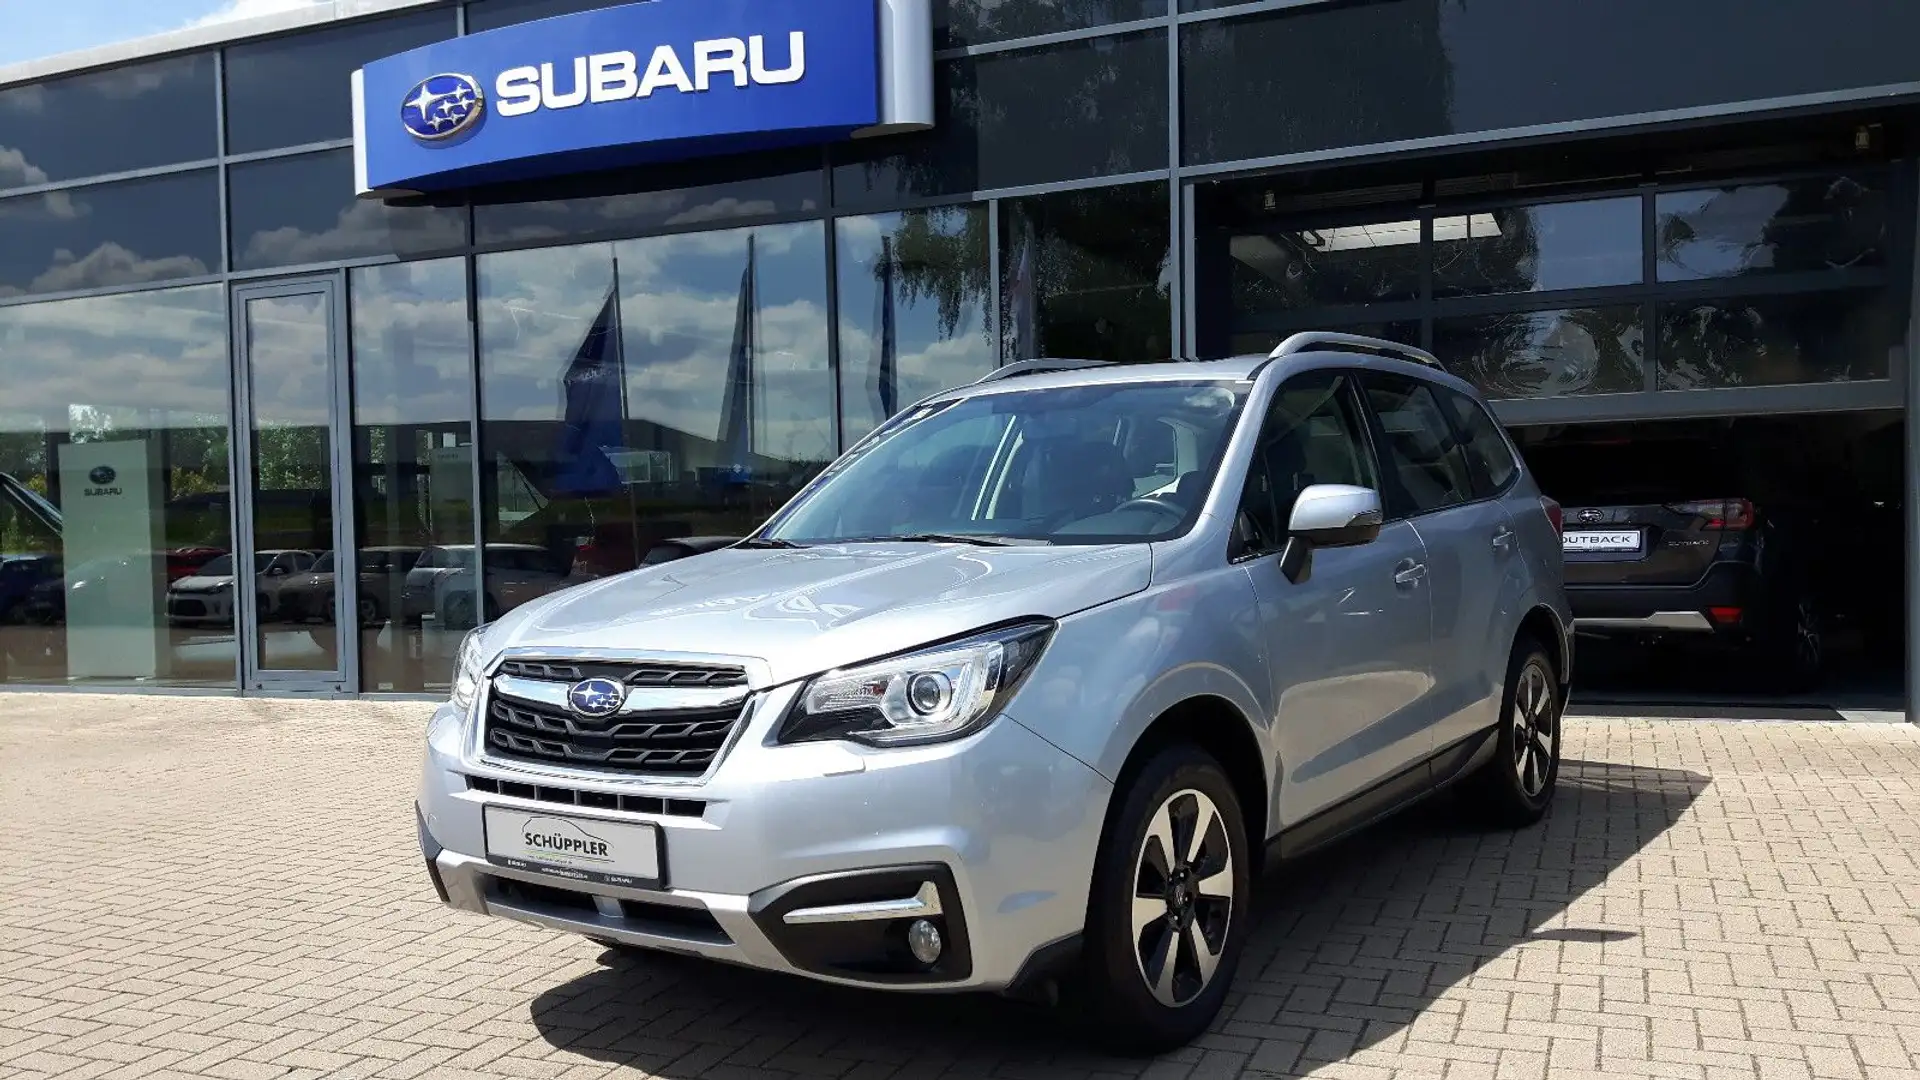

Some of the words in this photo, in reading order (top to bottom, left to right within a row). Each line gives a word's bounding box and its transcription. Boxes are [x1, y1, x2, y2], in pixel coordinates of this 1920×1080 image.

[496, 31, 804, 117] SUBARU
[84, 488, 122, 496] SUBARU
[525, 833, 608, 856] SCHÜPPLER
